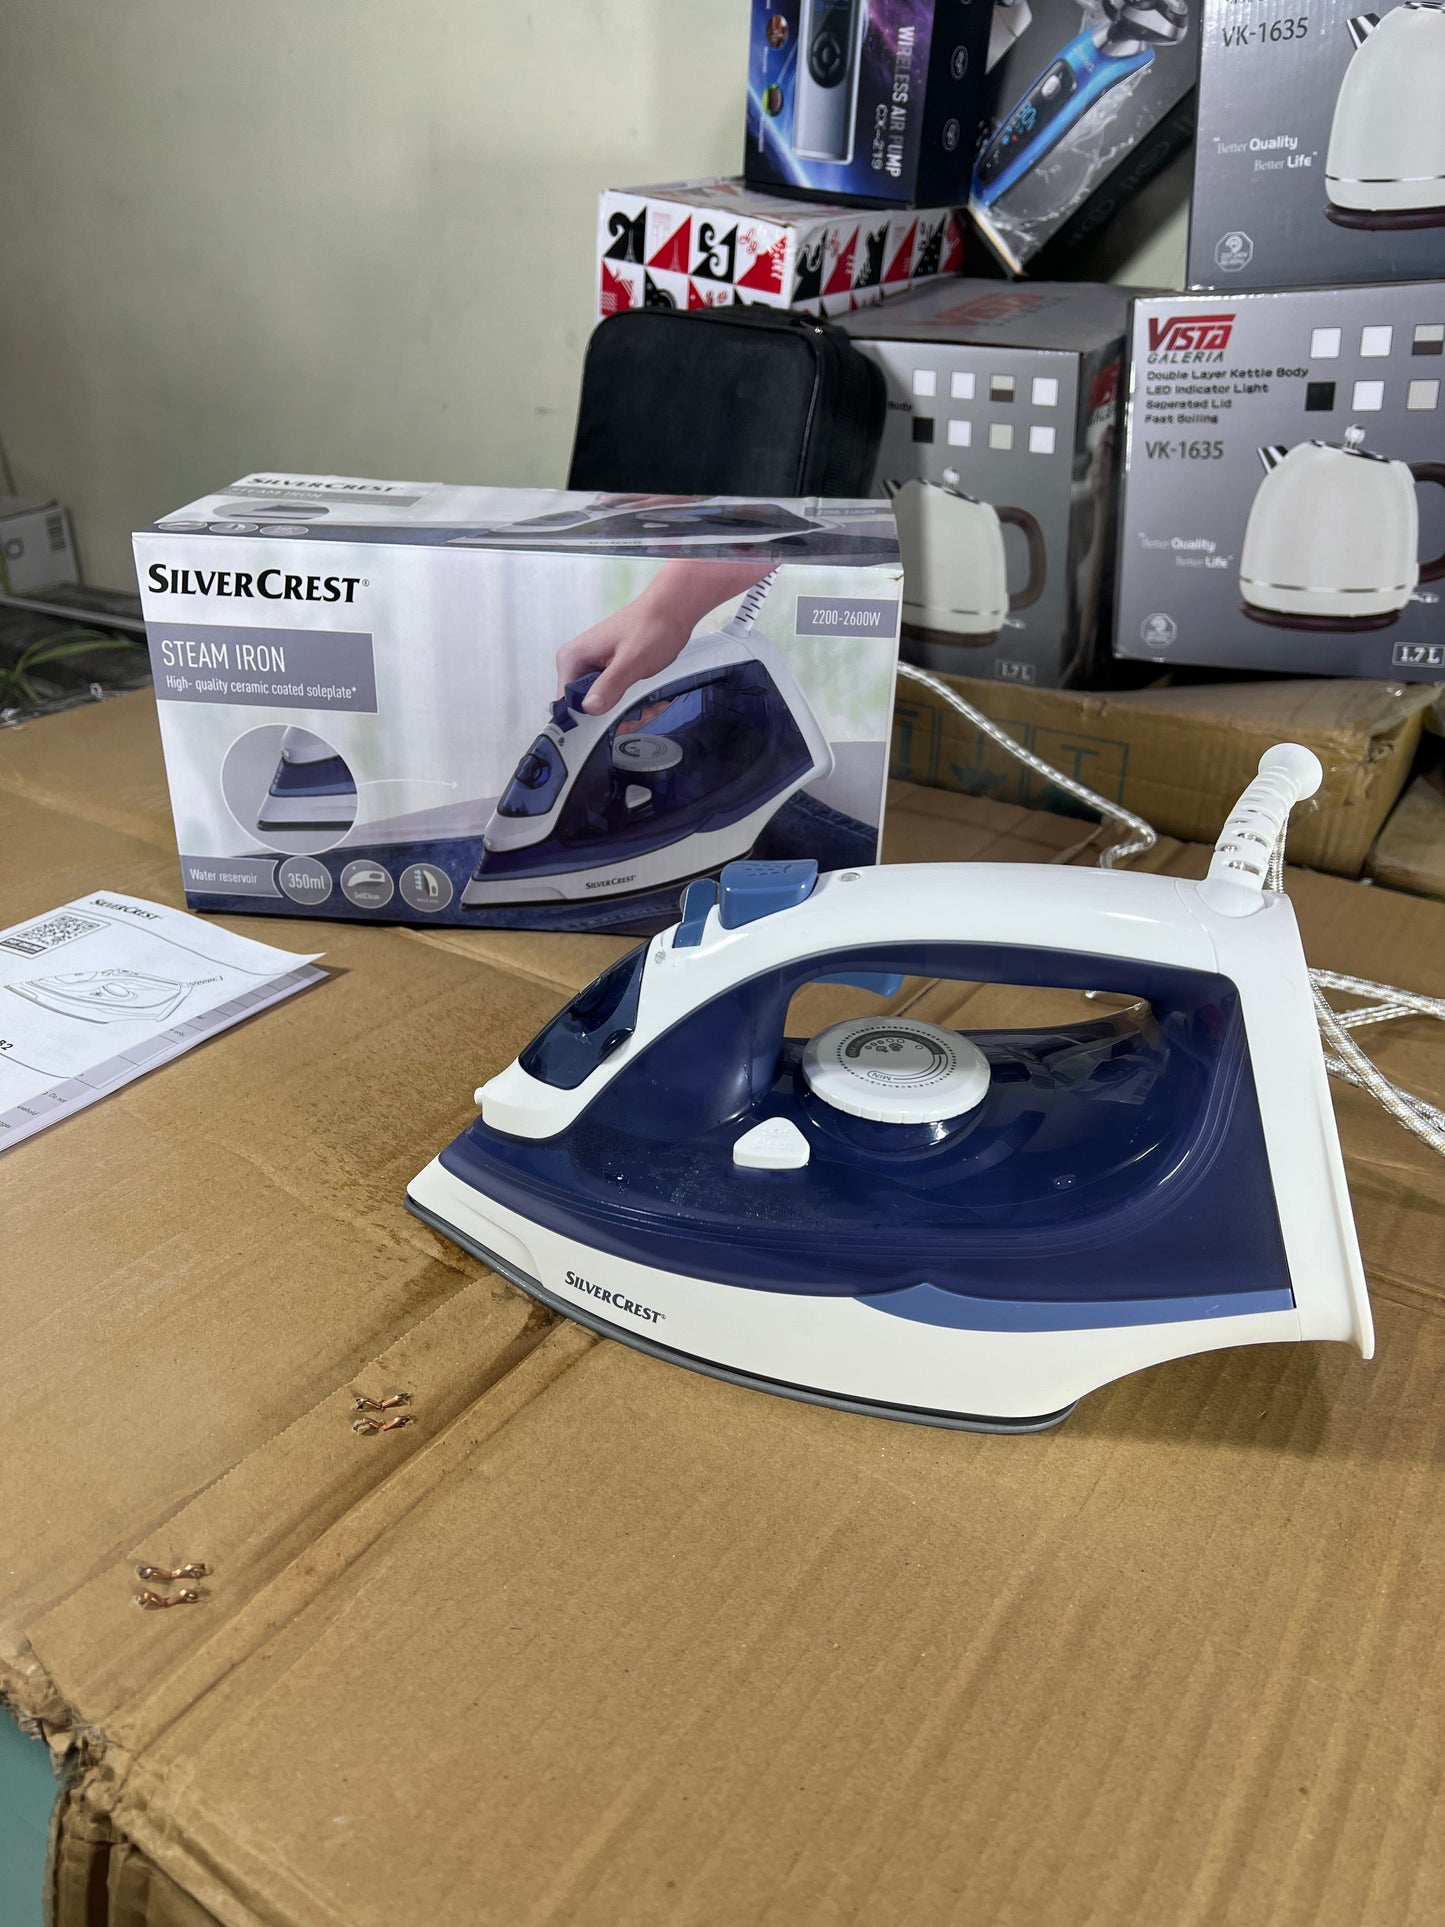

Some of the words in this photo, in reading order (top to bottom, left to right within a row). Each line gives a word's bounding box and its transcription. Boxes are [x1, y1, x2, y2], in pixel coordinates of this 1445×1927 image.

[1222, 17, 1308, 47] VK-1635
[891, 26, 915, 104] WIRELESS
[888, 105, 907, 131] AIR
[1249, 135, 1298, 151] Quality
[885, 134, 904, 177] PUMP
[1254, 159, 1286, 172] Better
[1147, 351, 1225, 364] GALERIA
[1147, 370, 1188, 381] Double
[1191, 369, 1227, 382] Layer
[1229, 368, 1273, 379] Kettle
[1276, 366, 1309, 379] Body
[1146, 385, 1171, 395] LED
[1175, 384, 1230, 395] Indicator
[1233, 383, 1270, 395] Light
[1211, 398, 1233, 409] Lid
[1145, 414, 1174, 424] Fast
[1177, 413, 1219, 425] Boiling
[1145, 440, 1224, 460] VK-1635
[1171, 537, 1217, 553] Quality
[812, 609, 881, 627] 2200-2600W
[161, 640, 229, 669] STEAM
[235, 644, 286, 673] IRON
[167, 675, 193, 693] High-
[195, 677, 228, 694] quality
[231, 680, 269, 694] ceramic
[271, 682, 304, 696] coated
[190, 868, 216, 881] Water
[219, 872, 257, 884] reservoir
[288, 873, 326, 890] 350ml
